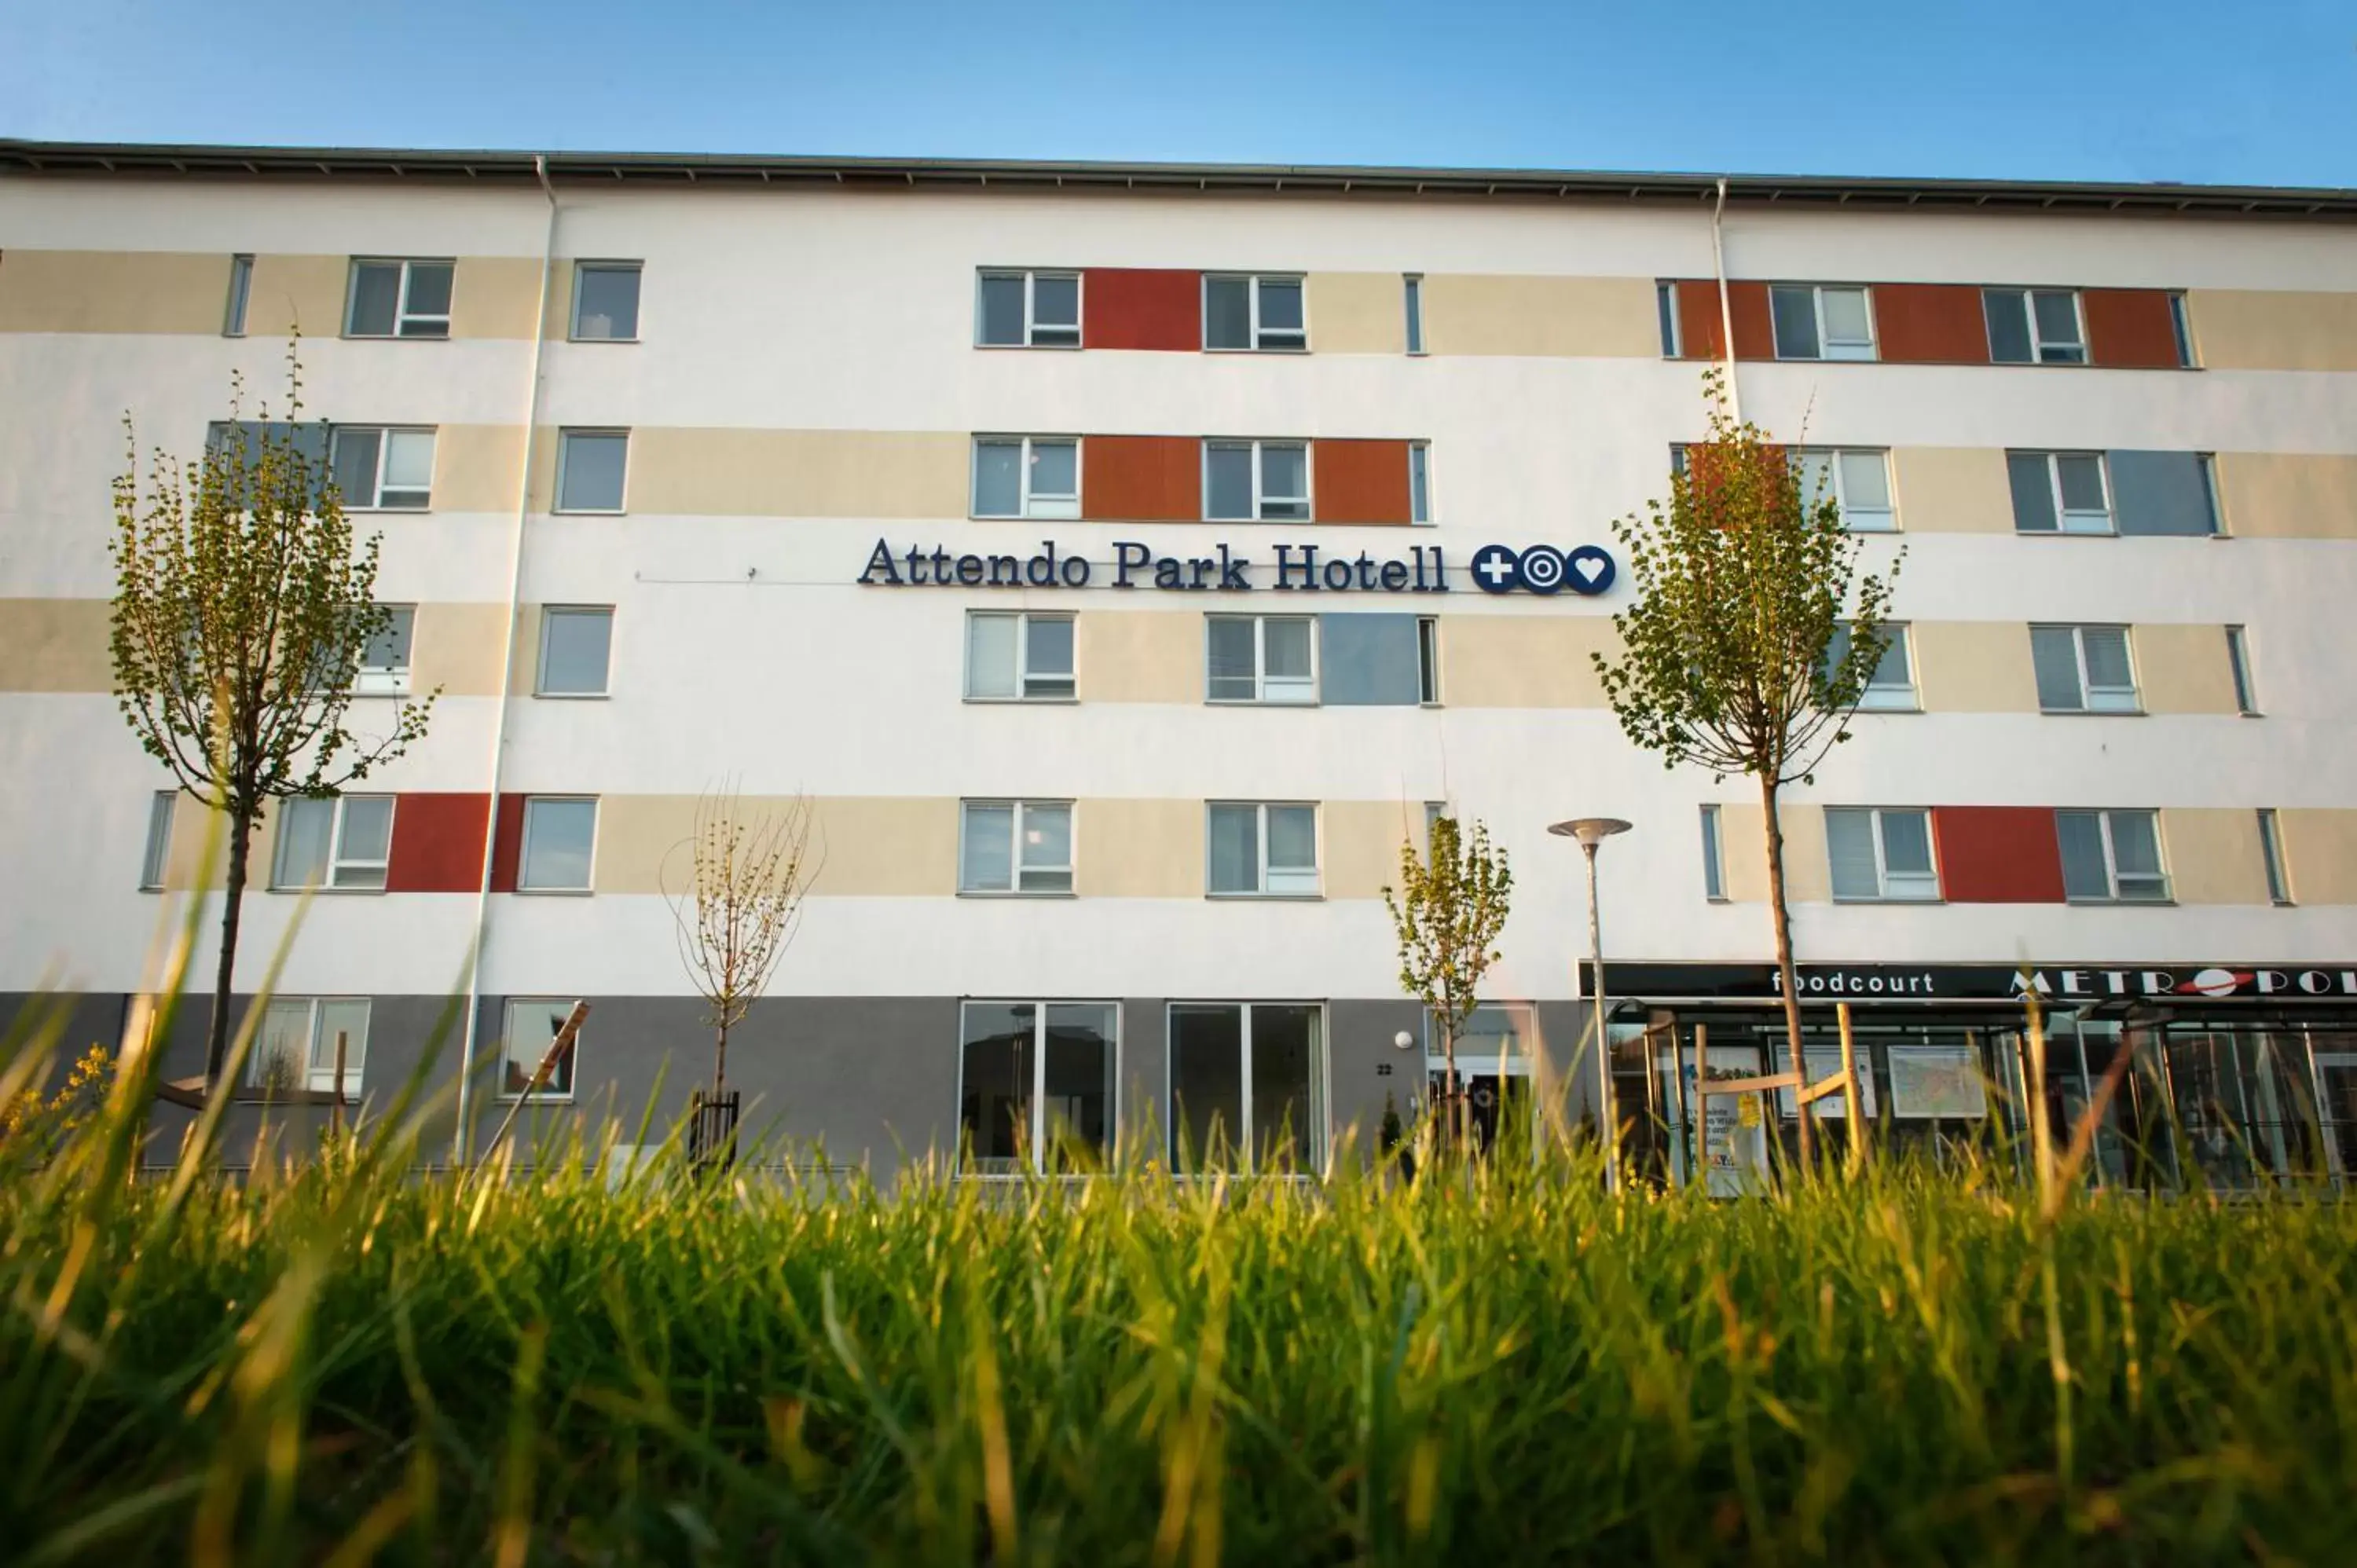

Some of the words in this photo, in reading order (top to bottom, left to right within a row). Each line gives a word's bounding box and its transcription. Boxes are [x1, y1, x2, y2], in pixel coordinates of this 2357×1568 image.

[856, 537, 1091, 587] Attendo
[1112, 542, 1252, 589] Park
[1272, 544, 1450, 592] Hotell
[1772, 972, 1934, 992] foodcourt
